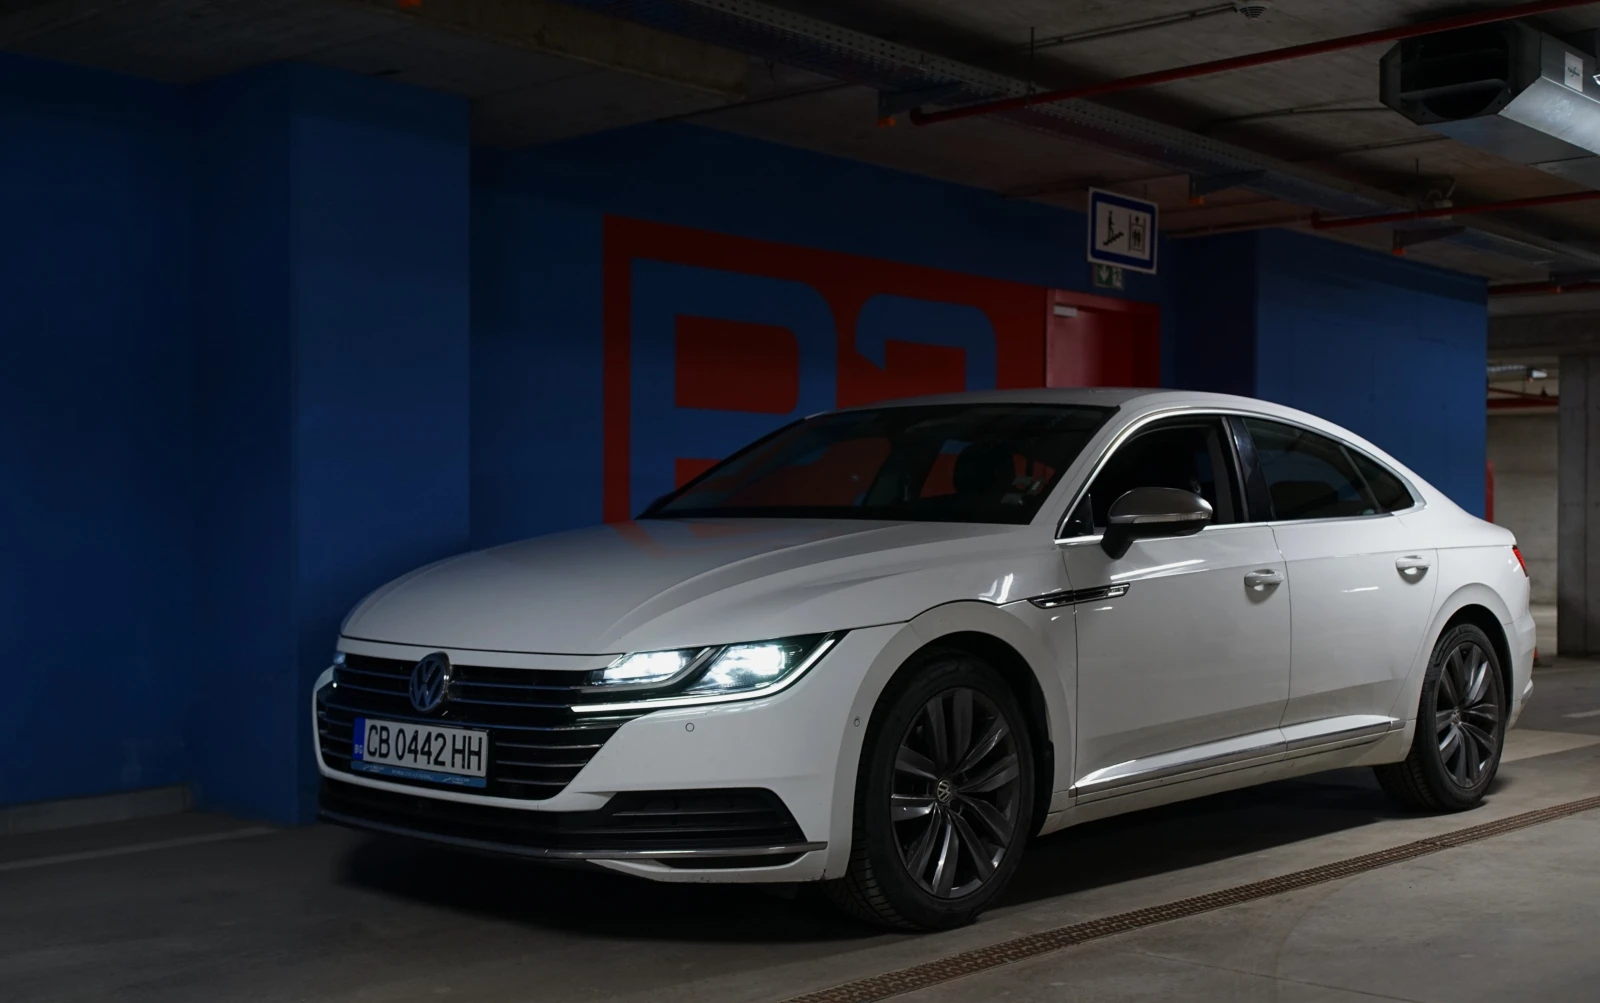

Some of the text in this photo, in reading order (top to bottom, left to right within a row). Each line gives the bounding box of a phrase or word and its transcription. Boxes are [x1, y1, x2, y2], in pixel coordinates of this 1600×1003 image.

[354, 743, 364, 754] BG
[367, 724, 482, 771] CB 0442 HH
